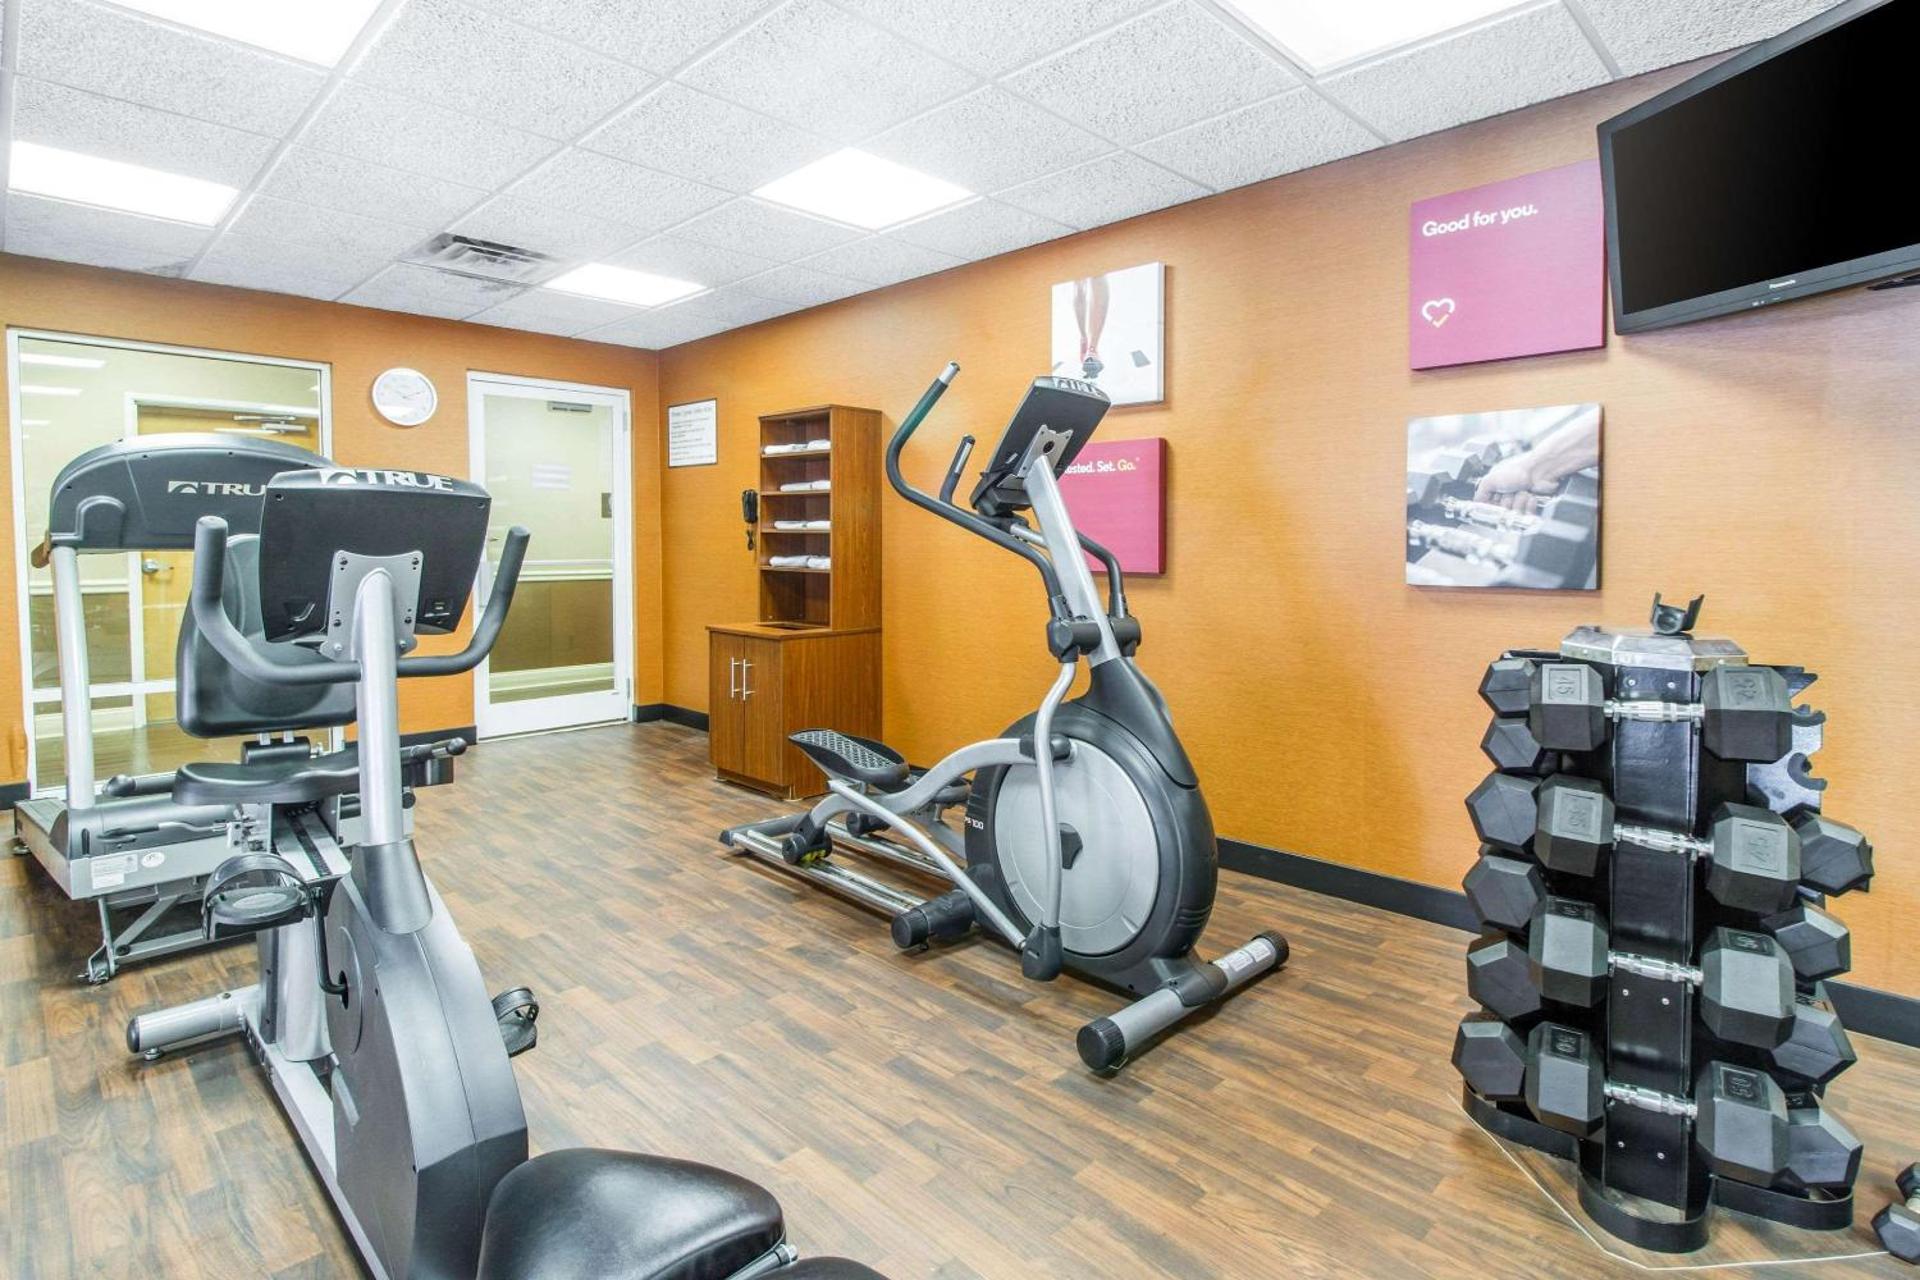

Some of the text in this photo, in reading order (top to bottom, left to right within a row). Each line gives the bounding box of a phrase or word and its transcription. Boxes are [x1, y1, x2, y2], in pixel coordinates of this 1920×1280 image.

[1422, 204, 1538, 237] Good for you.
[1065, 458, 1136, 474] ested. Set. Go.
[200, 481, 267, 496] TRU
[357, 470, 454, 492] TRUE
